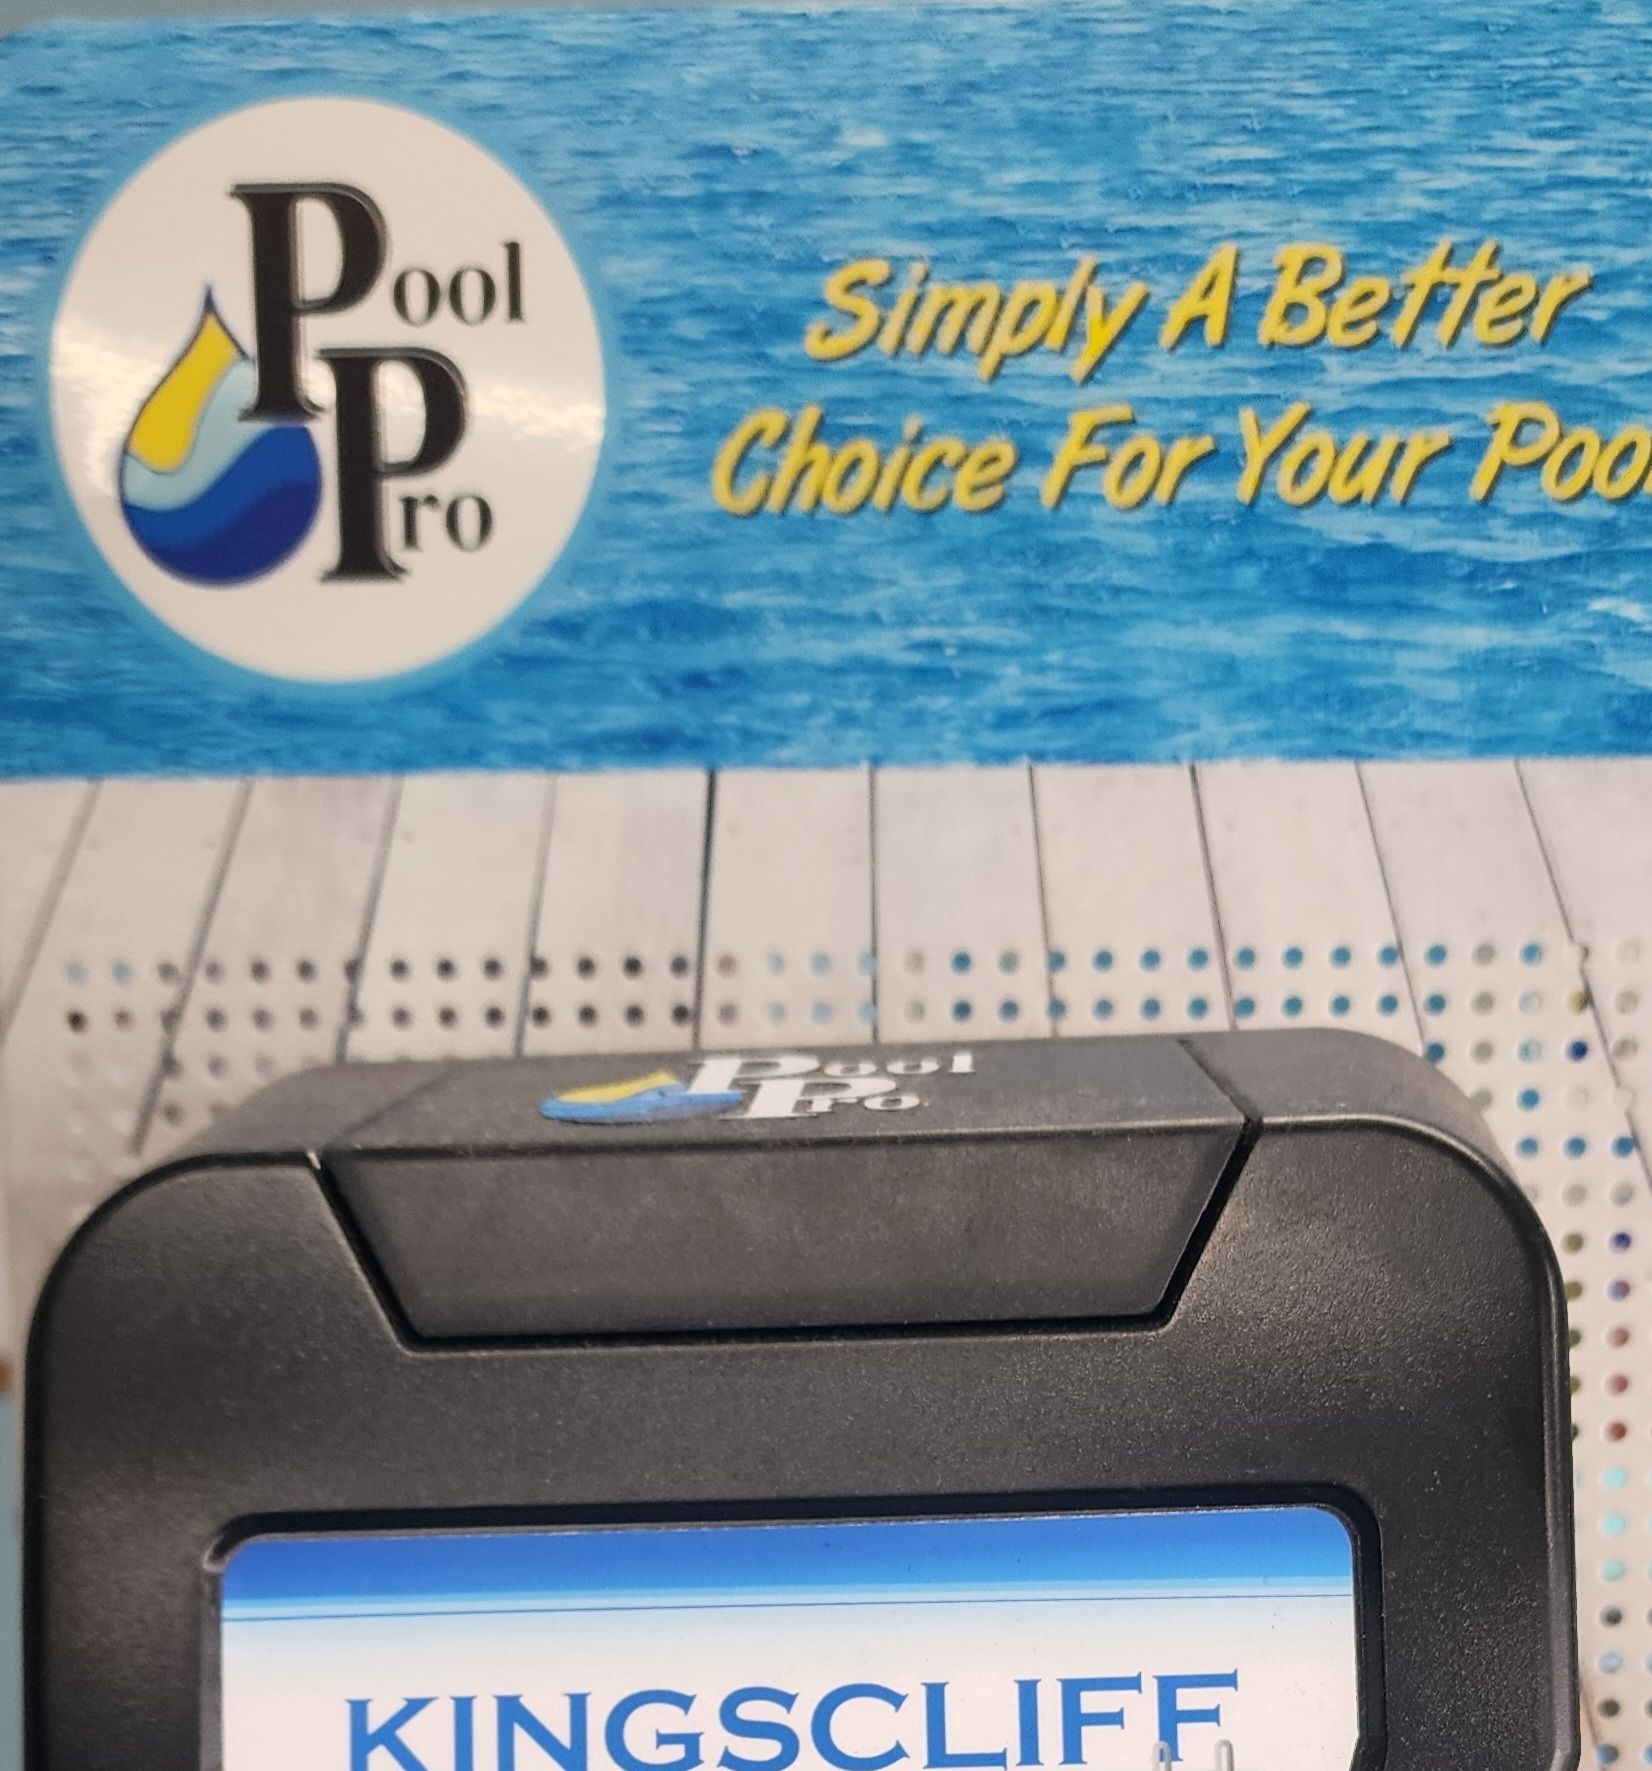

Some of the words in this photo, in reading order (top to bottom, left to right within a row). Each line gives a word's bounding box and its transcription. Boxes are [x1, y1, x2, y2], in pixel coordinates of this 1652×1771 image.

[230, 181, 528, 423] Pool
[805, 254, 1149, 386] Simply
[1160, 243, 1242, 349] A
[1257, 236, 1594, 350] Better
[316, 345, 495, 584] Pro
[711, 404, 1018, 516] Choice
[1040, 403, 1218, 512] For
[1235, 401, 1454, 509] Your
[1469, 401, 1652, 505] Poo
[687, 1050, 976, 1094] Pool
[718, 1077, 921, 1121] Pro
